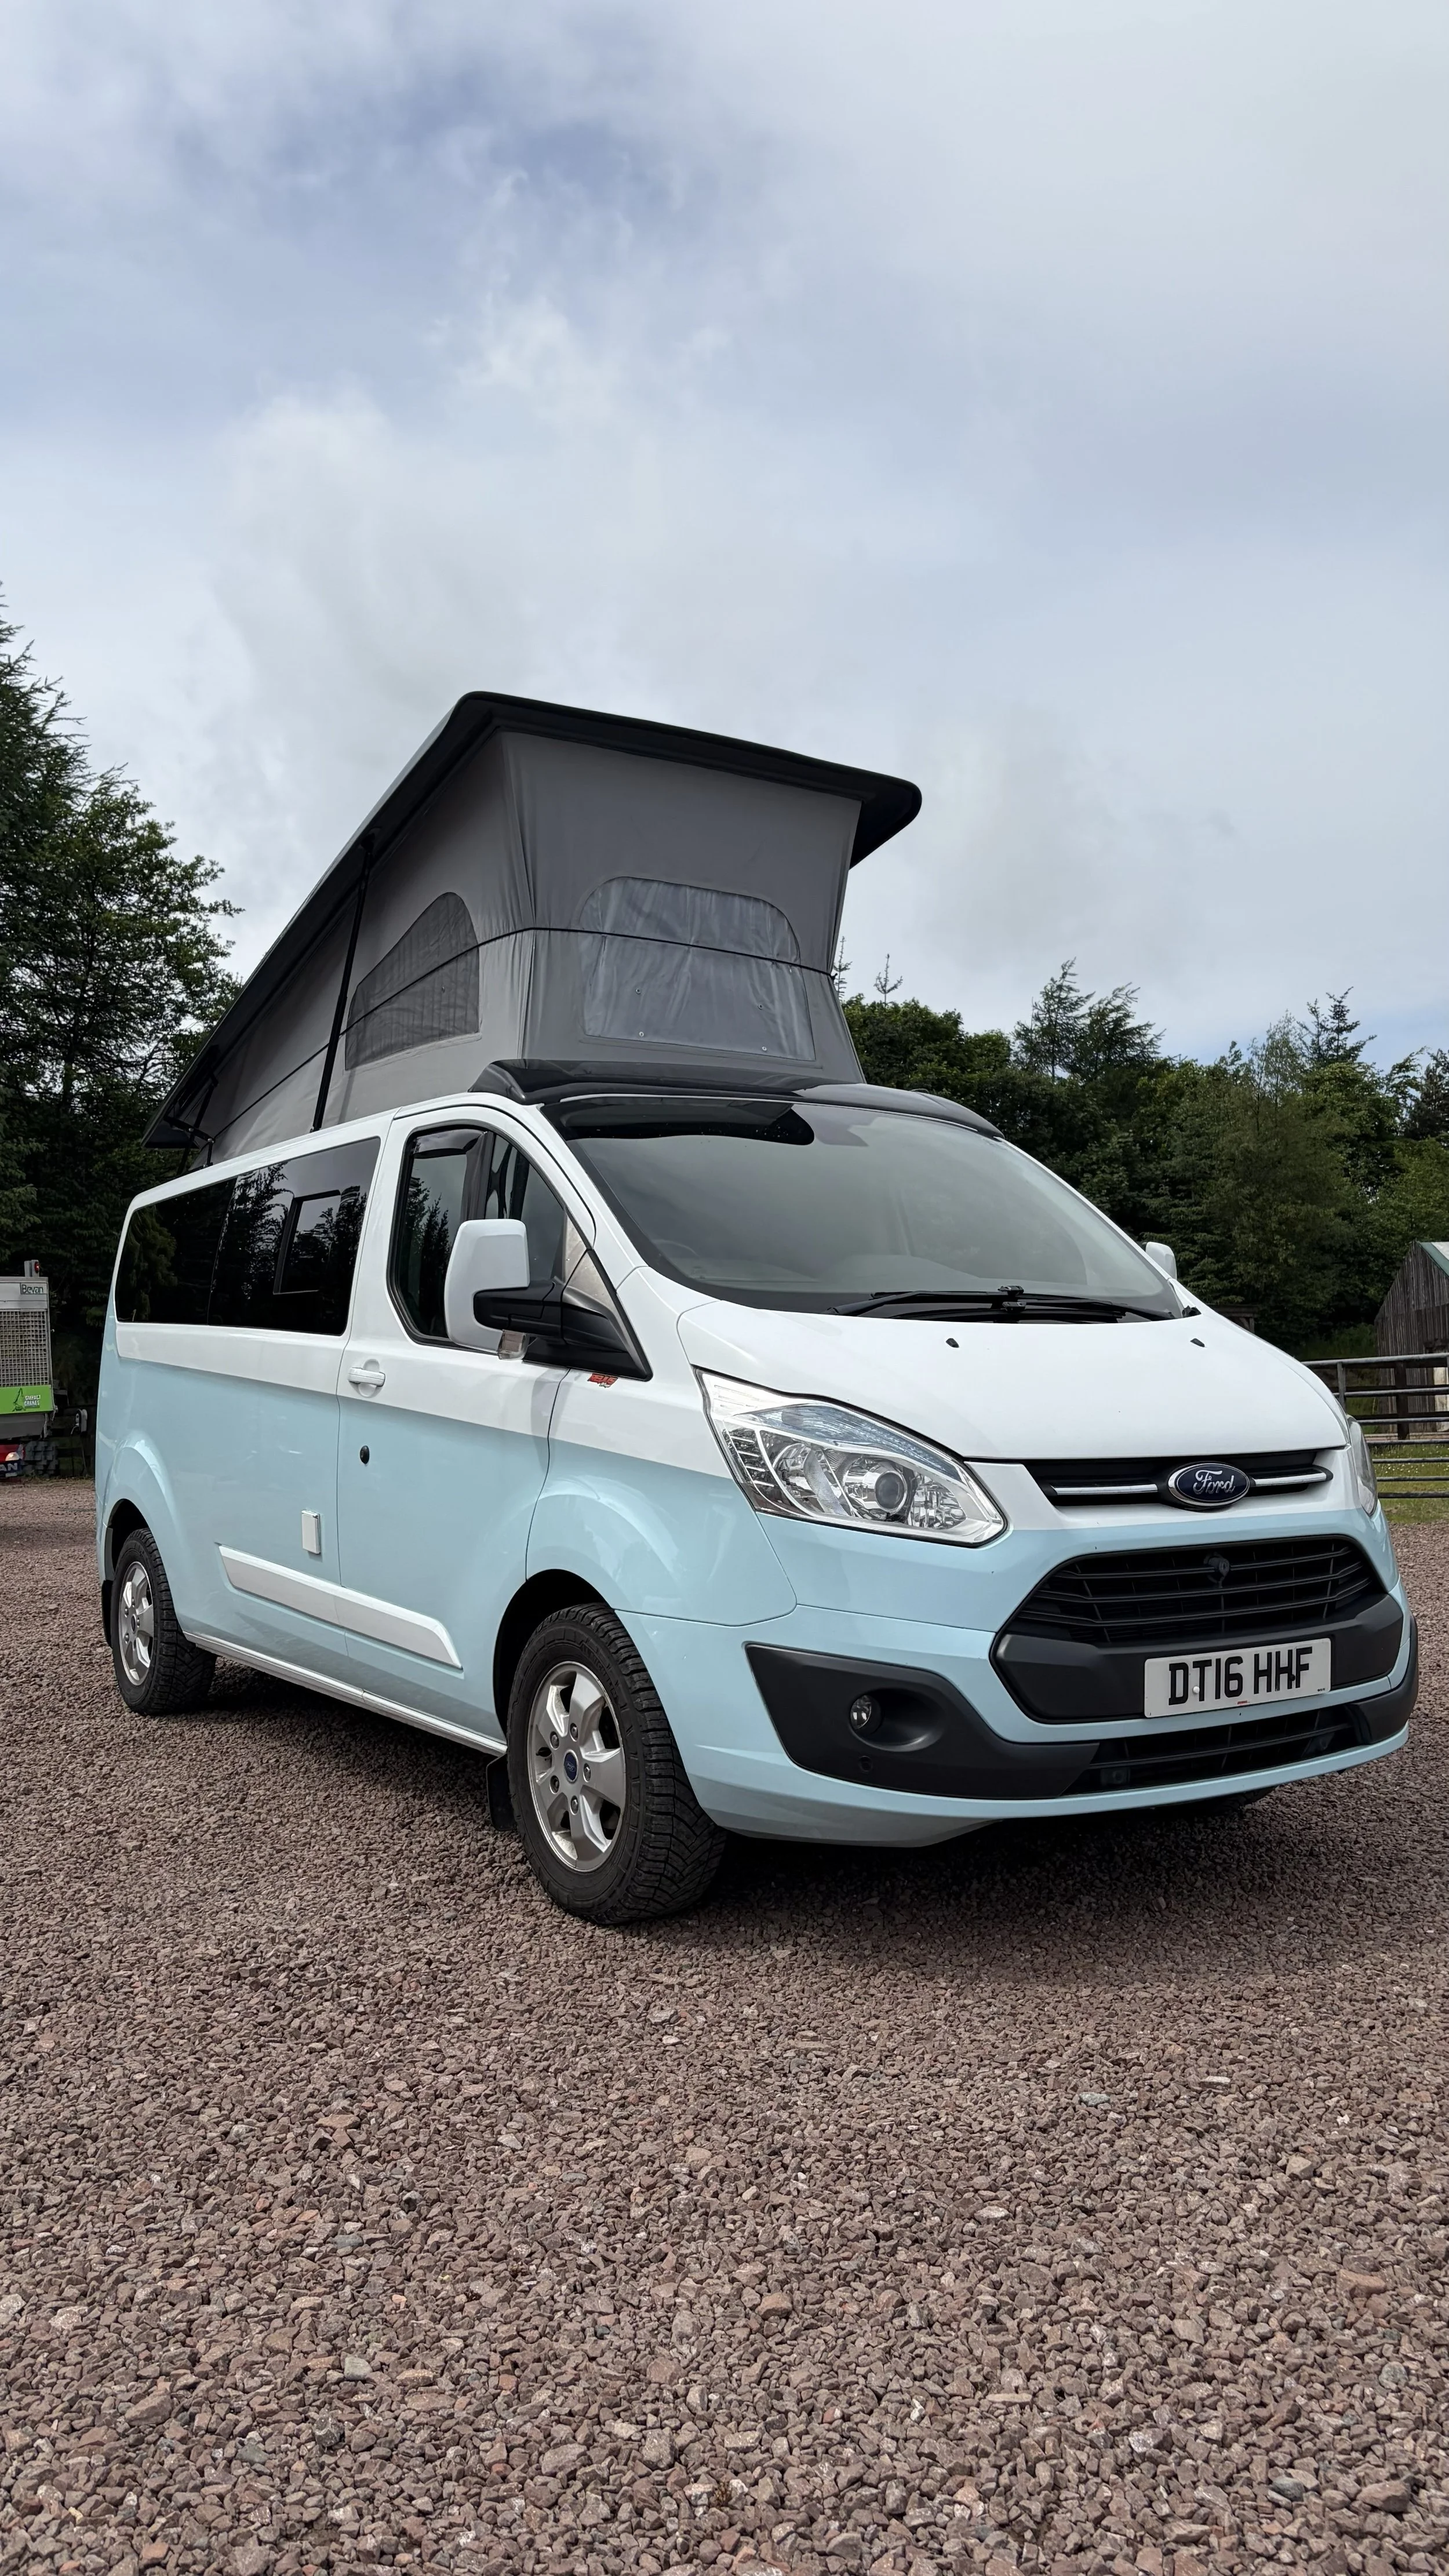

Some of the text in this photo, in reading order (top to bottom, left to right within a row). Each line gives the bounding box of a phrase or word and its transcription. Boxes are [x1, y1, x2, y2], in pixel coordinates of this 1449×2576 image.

[21, 1284, 43, 1293] Bevan
[1193, 1469, 1236, 1494] Ford
[1168, 1646, 1313, 1705] DT16 HHF
